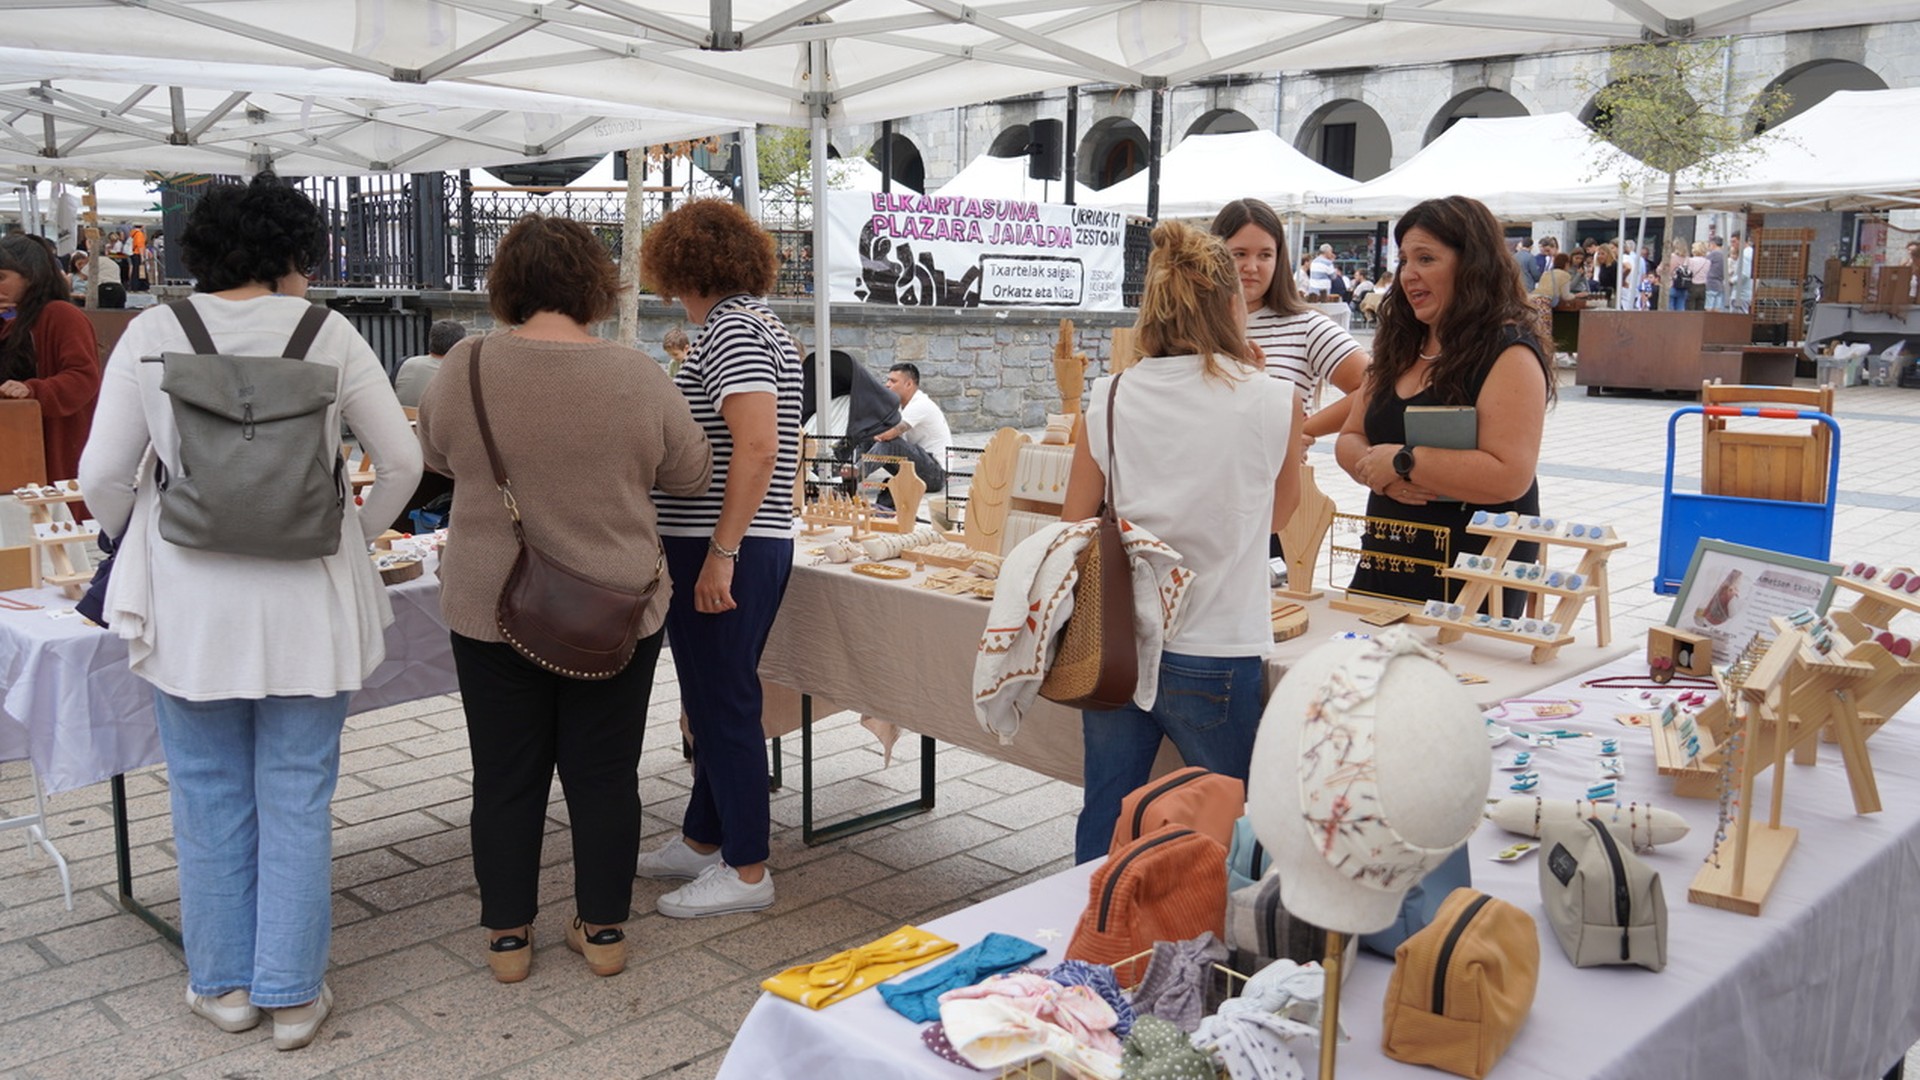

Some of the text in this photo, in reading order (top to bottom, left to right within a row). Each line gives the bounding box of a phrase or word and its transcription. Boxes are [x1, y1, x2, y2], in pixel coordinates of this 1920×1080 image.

[872, 191, 1040, 222] ELKARTASUNA
[1071, 208, 1110, 227] URRIAK
[872, 214, 1073, 249] PLAZARA JAIALDIA
[1075, 228, 1120, 247] ZESTOAN
[990, 263, 1045, 278] Txartelak
[992, 284, 1032, 298] Orkatz
[1034, 286, 1053, 299] eta
